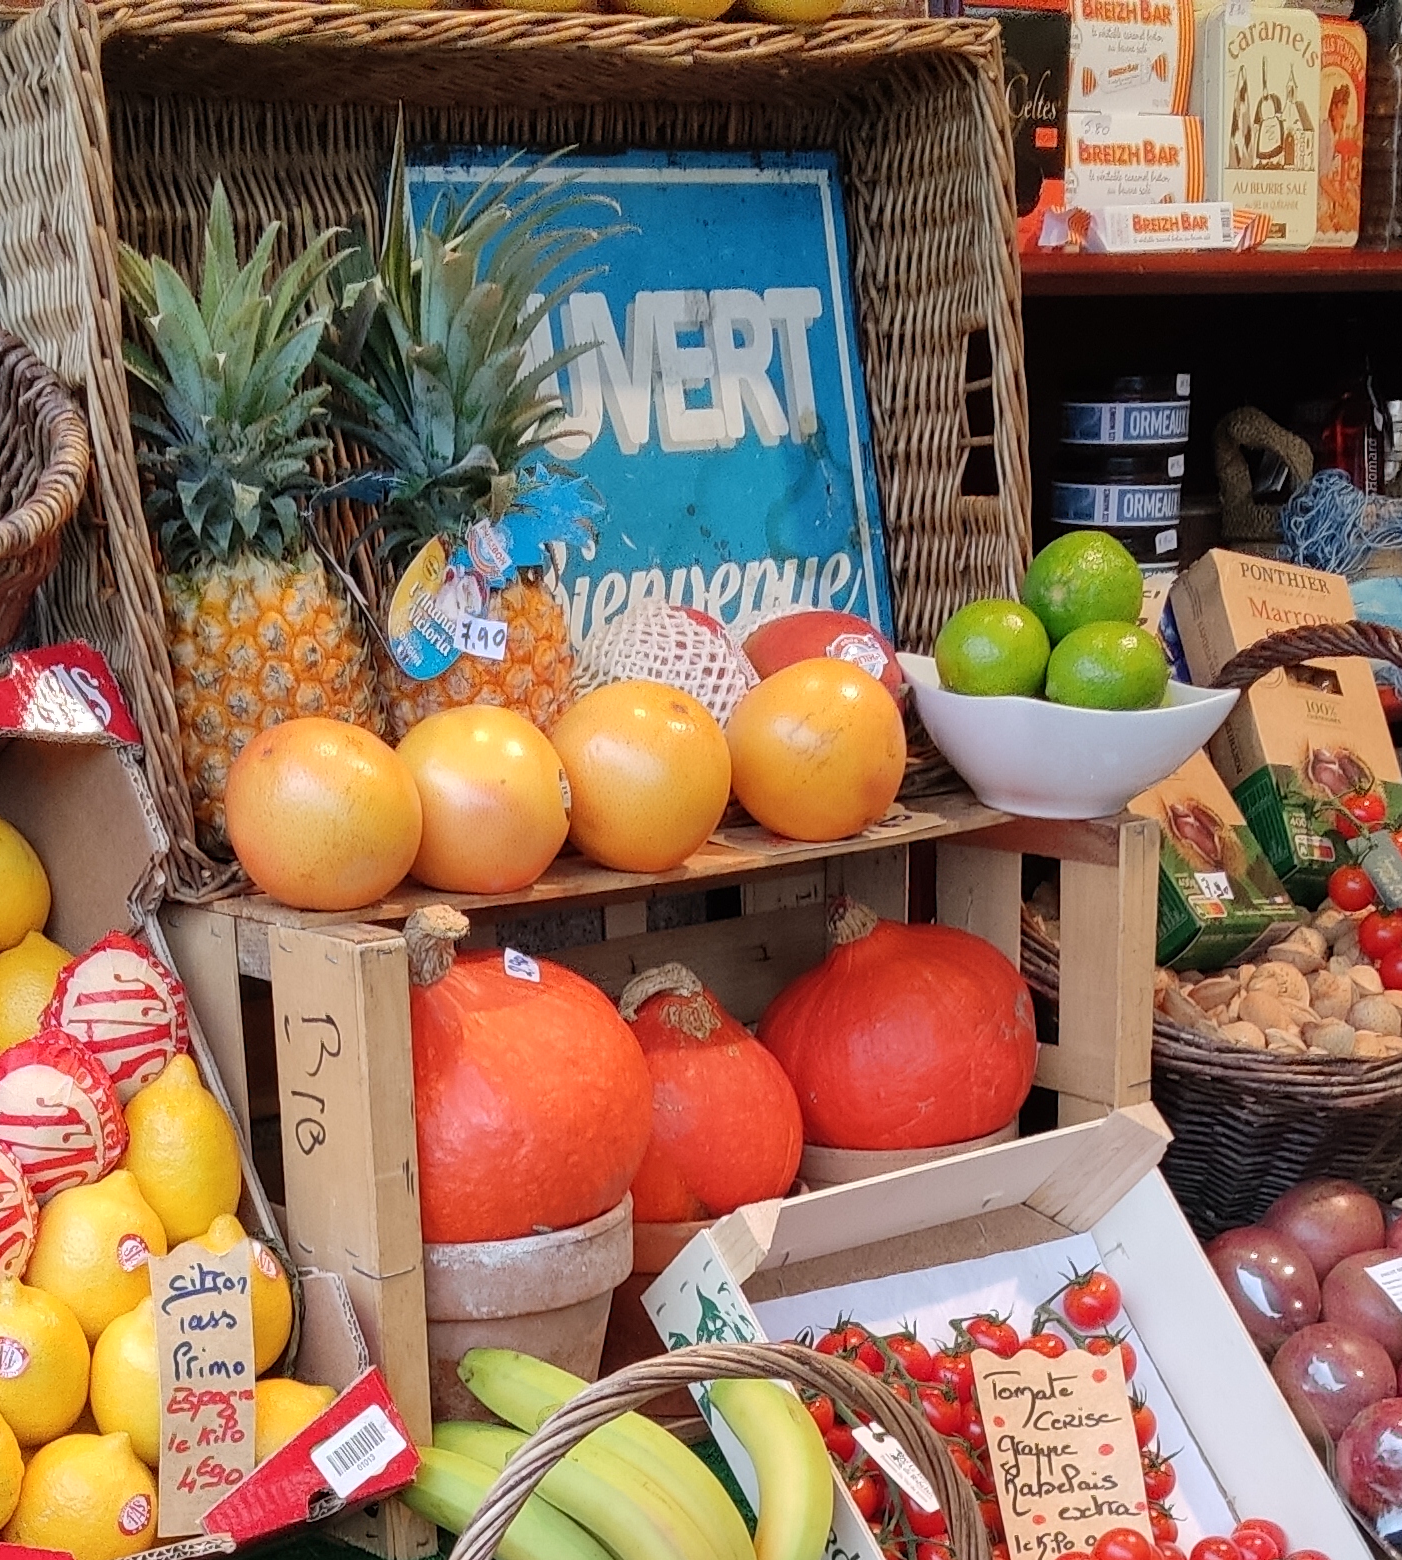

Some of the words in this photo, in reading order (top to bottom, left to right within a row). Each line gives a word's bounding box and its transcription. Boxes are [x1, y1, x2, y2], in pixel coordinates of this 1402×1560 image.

[1082, 0, 1138, 23] BREIZH
[1139, 0, 1172, 26] BAR
[1227, 20, 1319, 68] caramels
[1078, 136, 1140, 167] BREIZH
[1142, 138, 1181, 168] BAR
[1233, 181, 1249, 195] AU
[1250, 182, 1284, 196] BEURRE
[1132, 211, 1180, 235] BREIZH
[1180, 211, 1210, 232] BAR
[517, 286, 823, 460] UVERT
[1129, 408, 1188, 438] ORMEAUX
[1239, 561, 1331, 595] PONTHIER
[460, 620, 506, 652] 7.90
[1305, 699, 1339, 718] 100%
[172, 1340, 247, 1381] Primo
[982, 1370, 1078, 1429] Tomate
[356, 1453, 377, 1473] 01013
